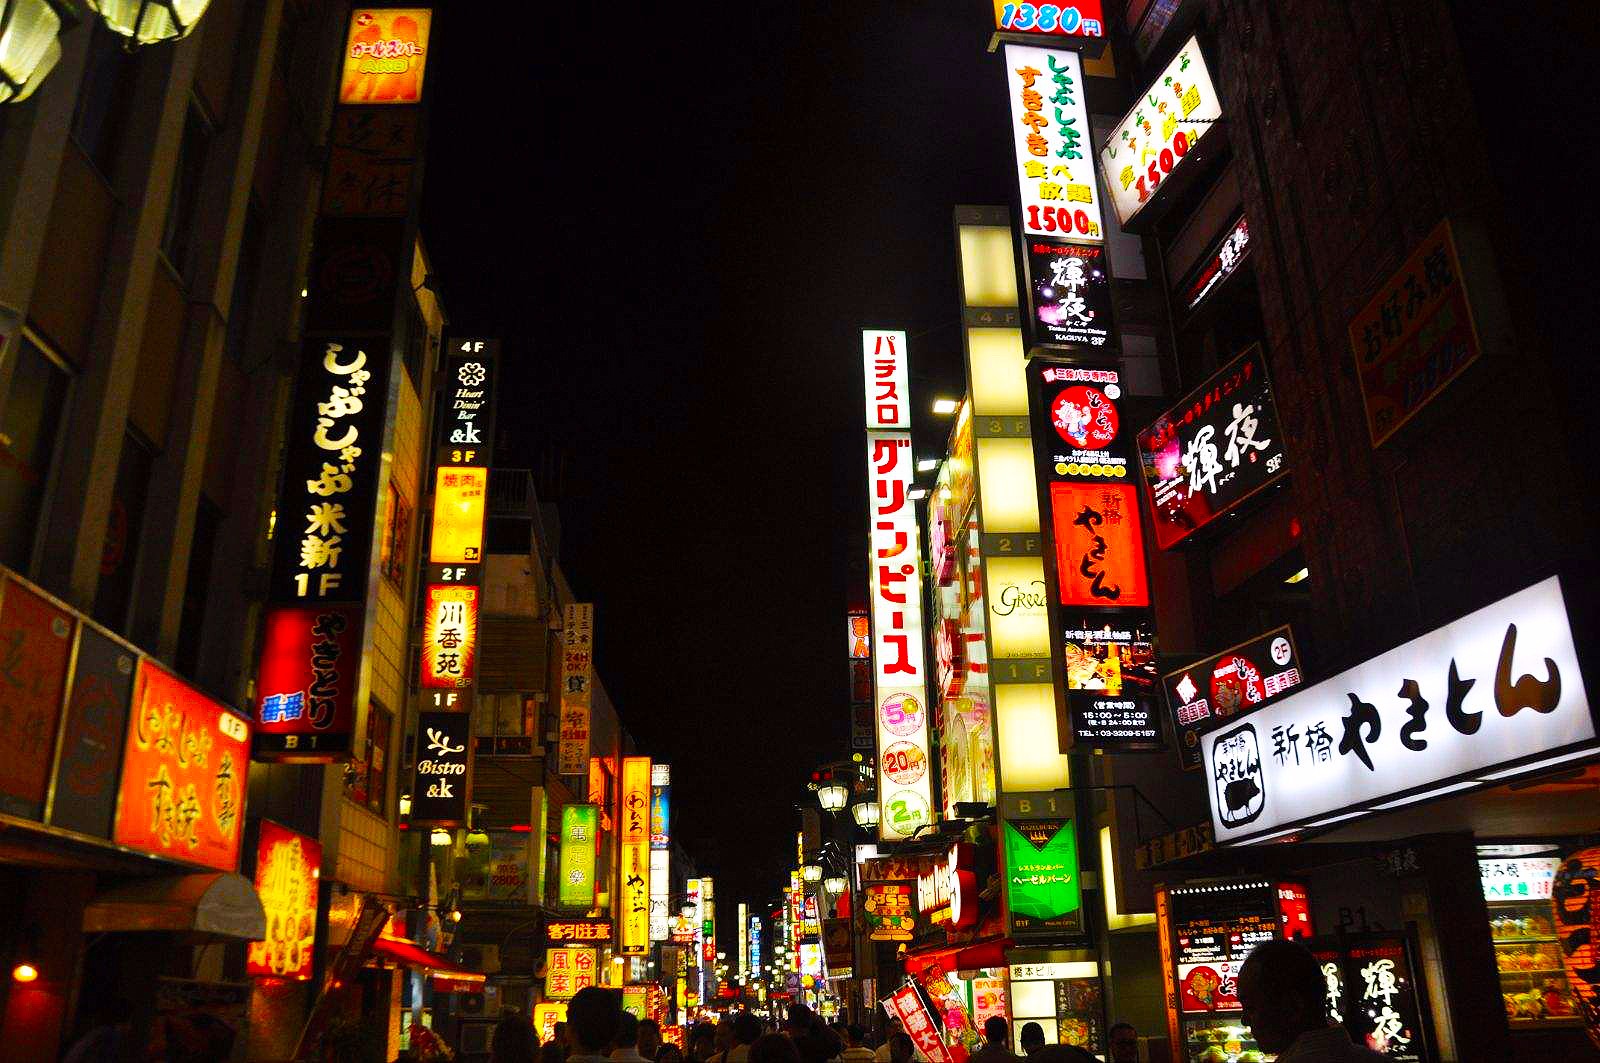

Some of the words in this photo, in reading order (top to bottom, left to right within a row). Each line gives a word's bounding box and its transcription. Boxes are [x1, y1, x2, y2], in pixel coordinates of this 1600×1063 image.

[1001, 3, 1102, 36] 1380円
[1015, 65, 1049, 157] すきやき
[1047, 54, 1083, 160] しゃぶしゃぶ
[1134, 129, 1199, 203] 1500円
[1027, 204, 1100, 237] 1500円
[1050, 257, 1094, 323] 輝夜
[461, 341, 484, 353] 4F
[452, 451, 476, 463] 3F
[1181, 402, 1271, 499] 輝夜
[873, 439, 916, 675] グリンピース
[1072, 505, 1121, 601] やきとん
[294, 573, 343, 598] 1F
[441, 568, 467, 581] 2F
[436, 604, 463, 676] 川香苑
[432, 693, 458, 707] 1F
[418, 760, 466, 777] Bistro
[1011, 873, 1073, 886] ヘーゼルバーン
